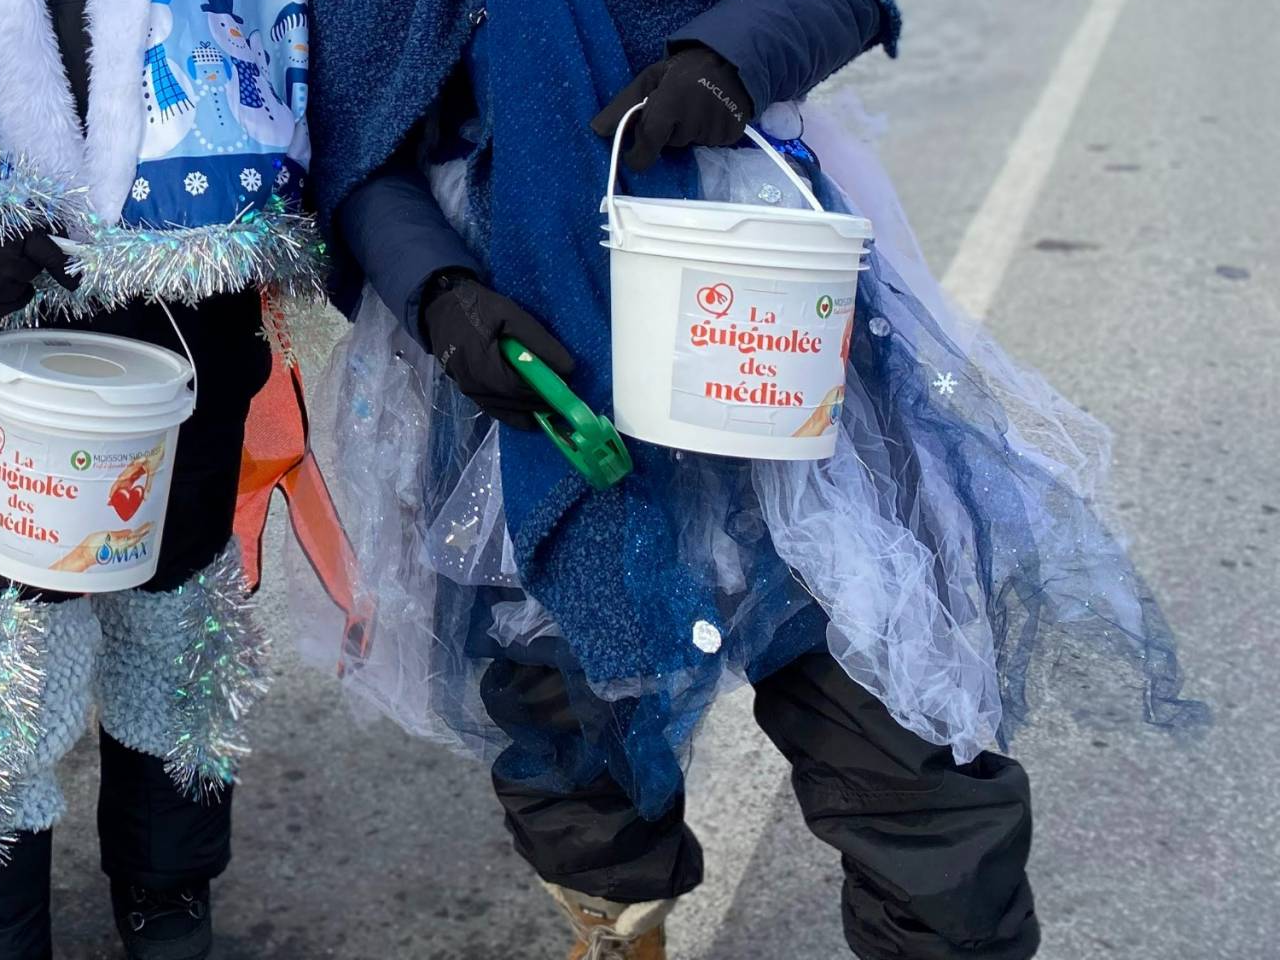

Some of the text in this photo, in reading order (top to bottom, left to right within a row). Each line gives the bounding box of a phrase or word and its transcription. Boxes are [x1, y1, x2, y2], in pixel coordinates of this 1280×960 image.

[697, 77, 738, 113] AUCLAIR
[750, 306, 776, 324] La
[690, 319, 823, 354] guignolée
[739, 357, 777, 377] des
[704, 381, 804, 407] médias
[15, 450, 34, 470] La
[7, 493, 34, 514] des
